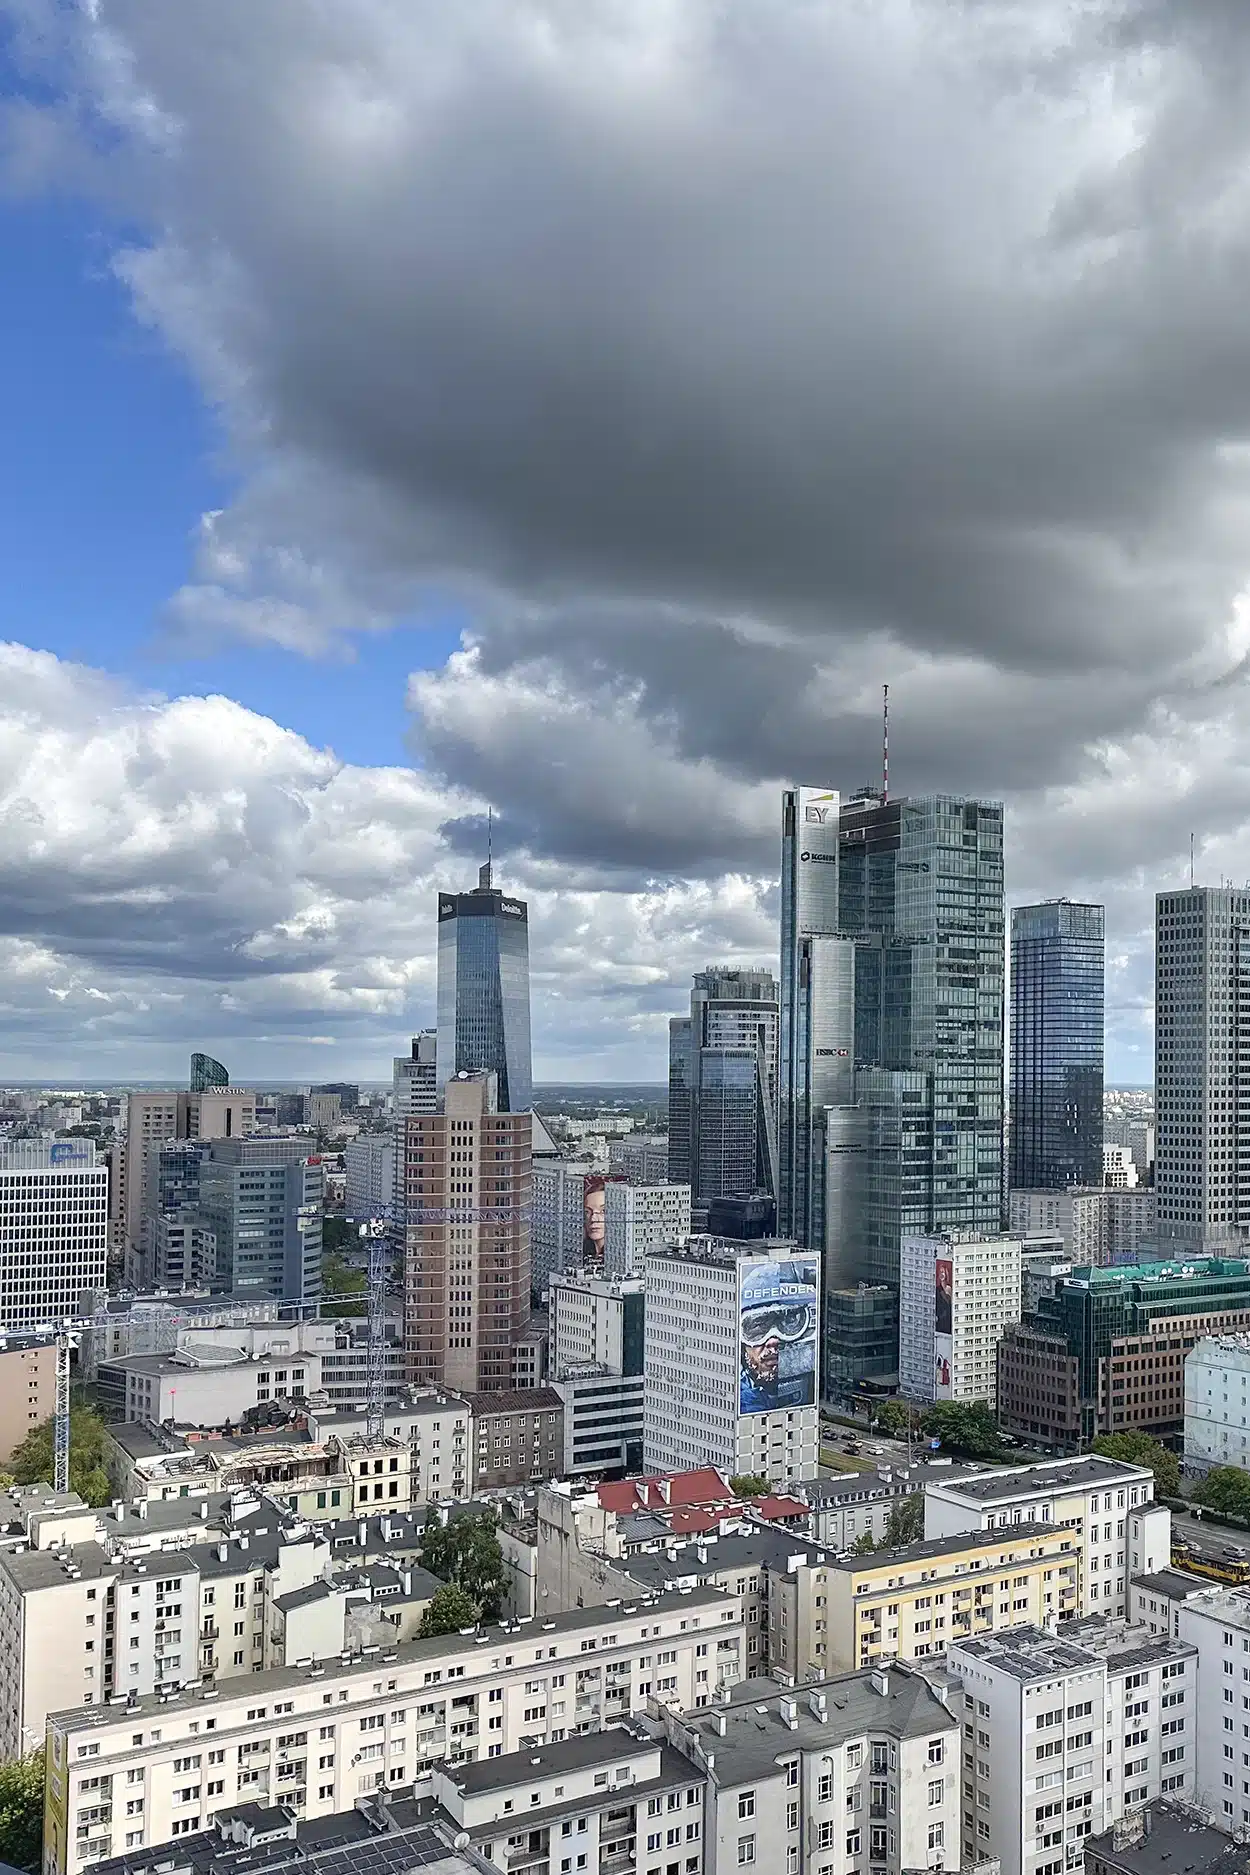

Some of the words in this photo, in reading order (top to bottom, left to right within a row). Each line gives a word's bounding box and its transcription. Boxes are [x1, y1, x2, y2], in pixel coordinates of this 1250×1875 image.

[806, 806, 829, 824] EY
[816, 1048, 836, 1056] HSBC
[744, 1284, 815, 1299] DEFENDER
